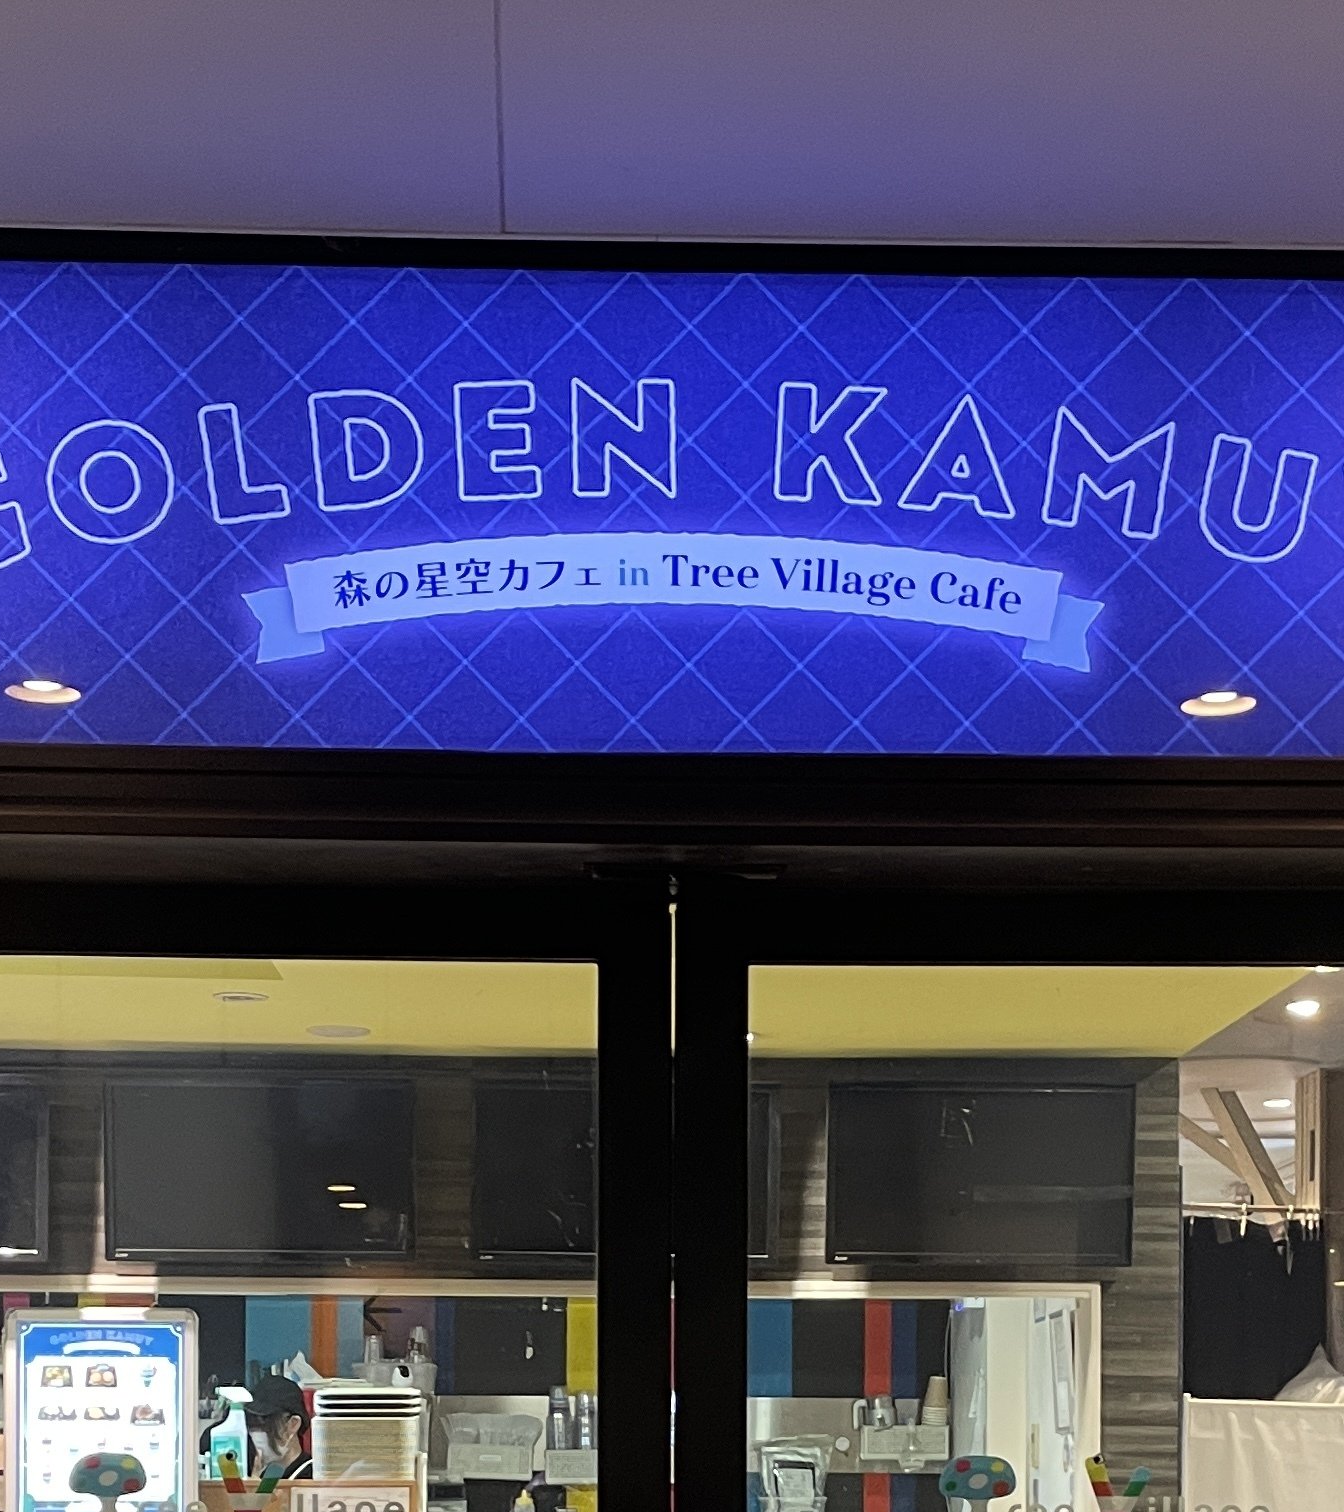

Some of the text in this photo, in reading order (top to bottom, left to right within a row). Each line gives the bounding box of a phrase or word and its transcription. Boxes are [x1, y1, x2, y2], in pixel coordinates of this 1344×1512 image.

[333, 553, 1022, 615] 森の星空カフェ in Tree Village Cafe
